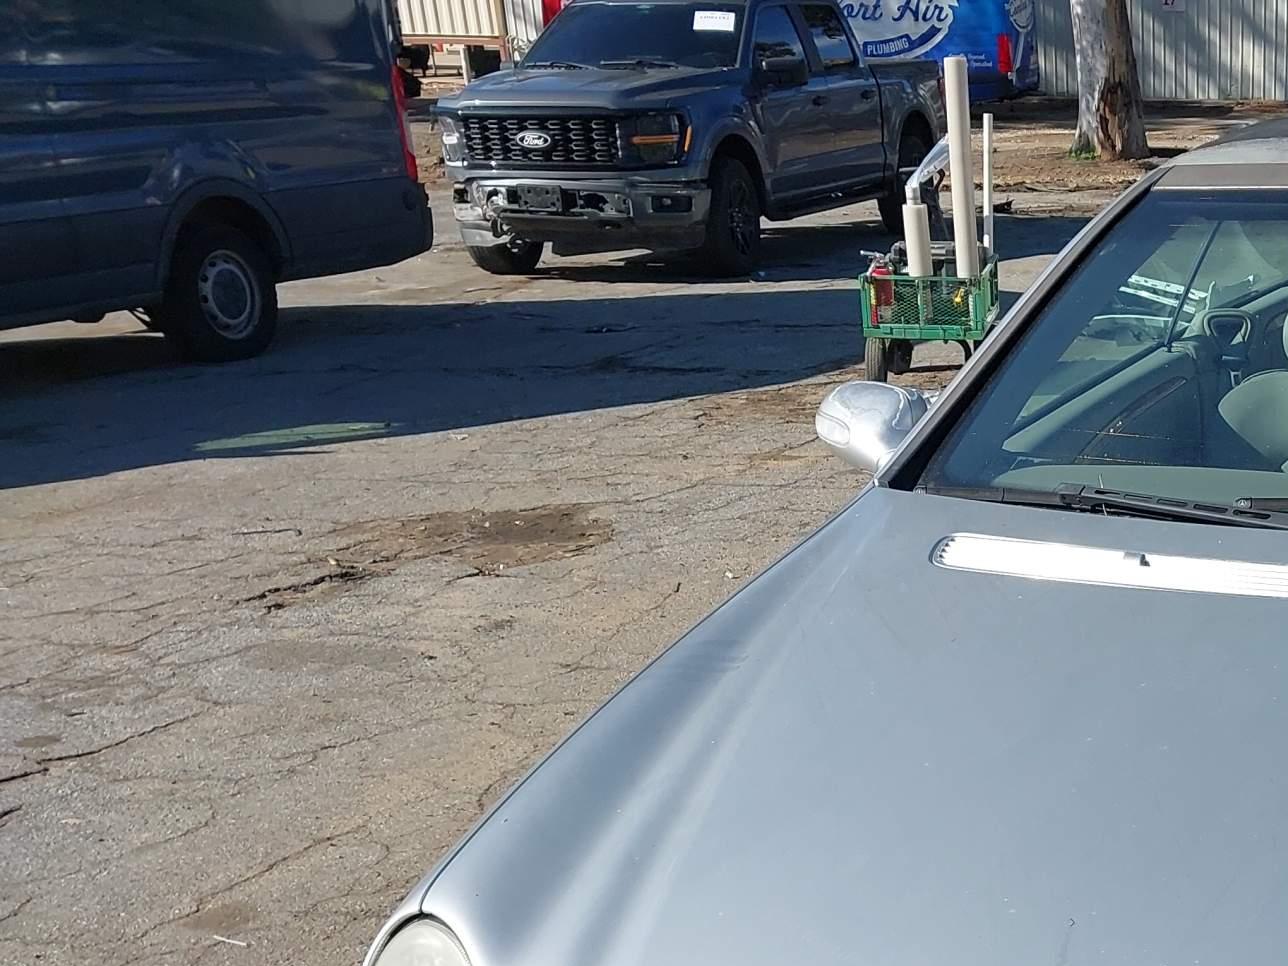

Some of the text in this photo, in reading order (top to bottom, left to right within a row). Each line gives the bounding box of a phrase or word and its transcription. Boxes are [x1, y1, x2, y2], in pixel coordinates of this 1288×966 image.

[892, 0, 949, 22] Air
[867, 38, 909, 55] PLUMBING
[523, 135, 544, 145] Ford
